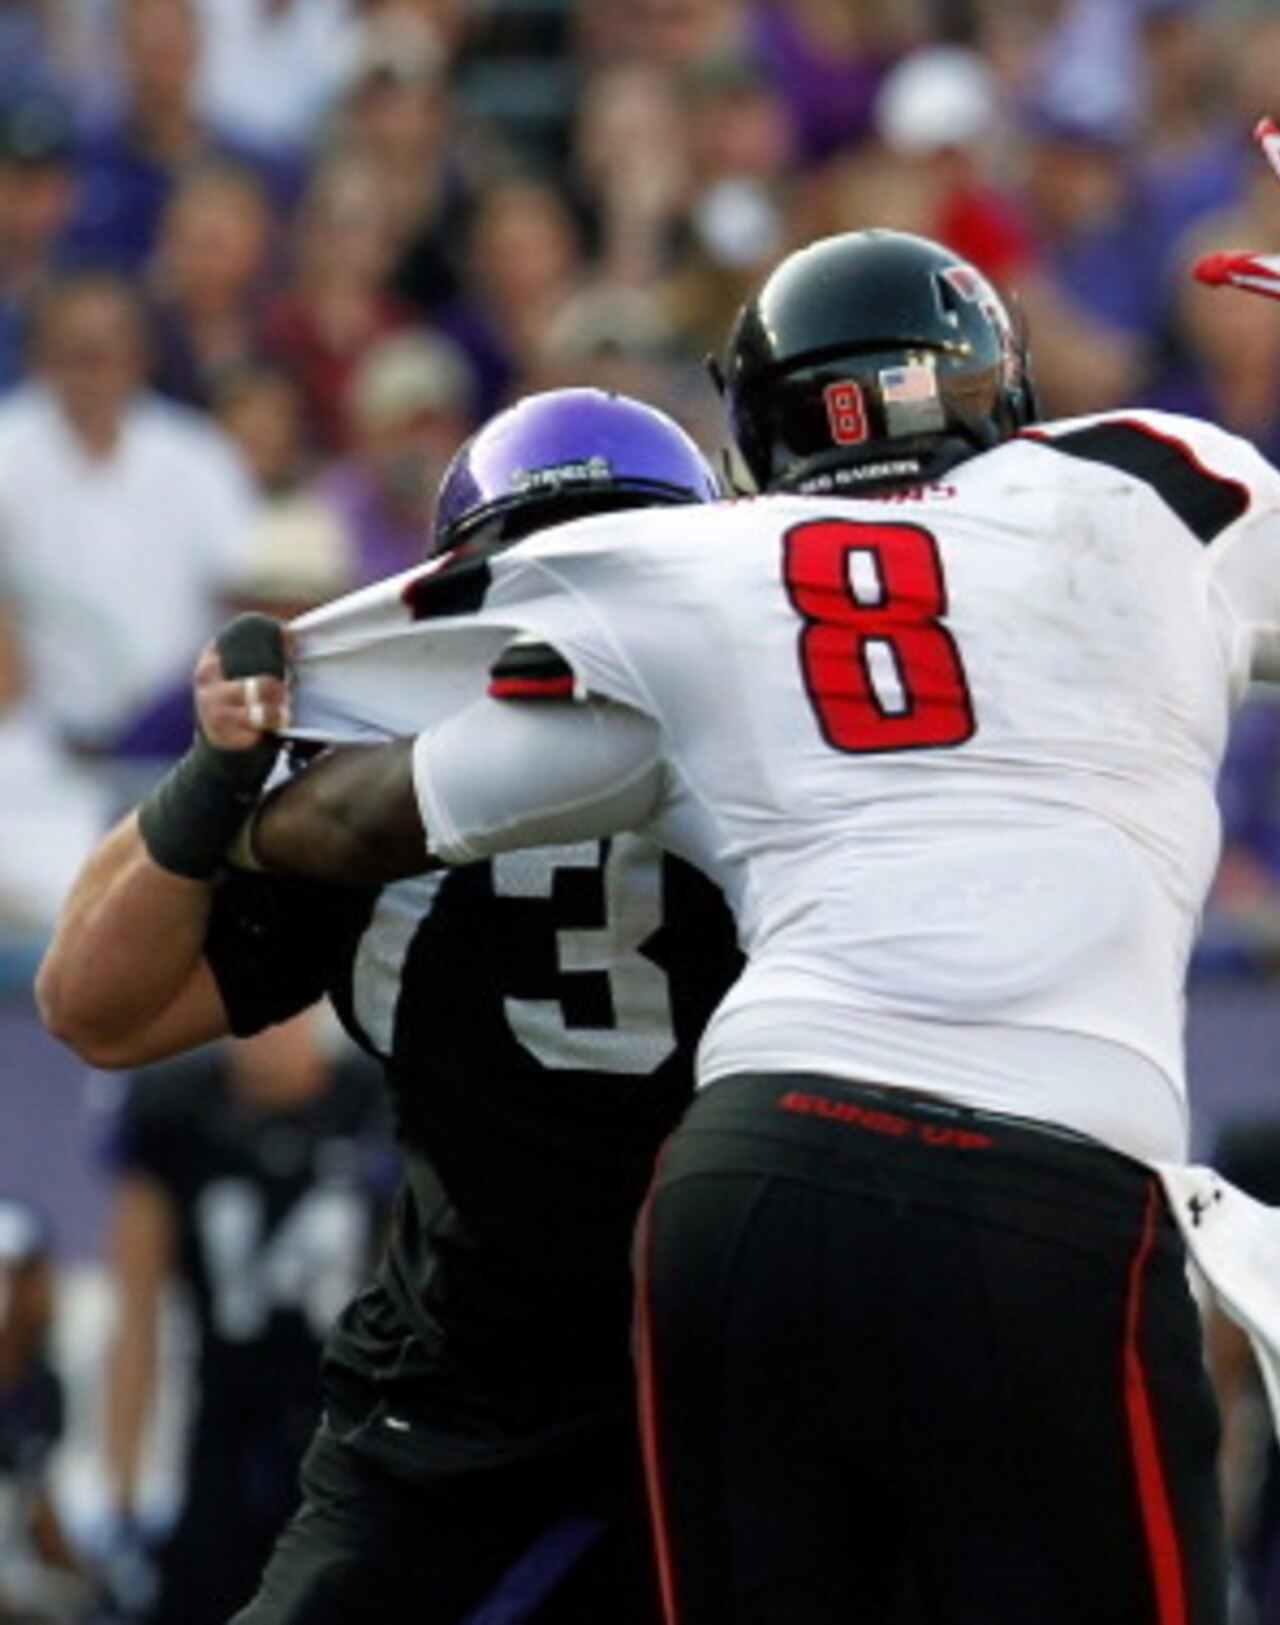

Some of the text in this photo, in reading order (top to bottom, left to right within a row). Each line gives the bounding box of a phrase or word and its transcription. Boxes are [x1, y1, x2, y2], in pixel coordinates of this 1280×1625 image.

[823, 379, 868, 445] 8
[781, 516, 977, 755] 8
[780, 1092, 993, 1148] GUNS UP
